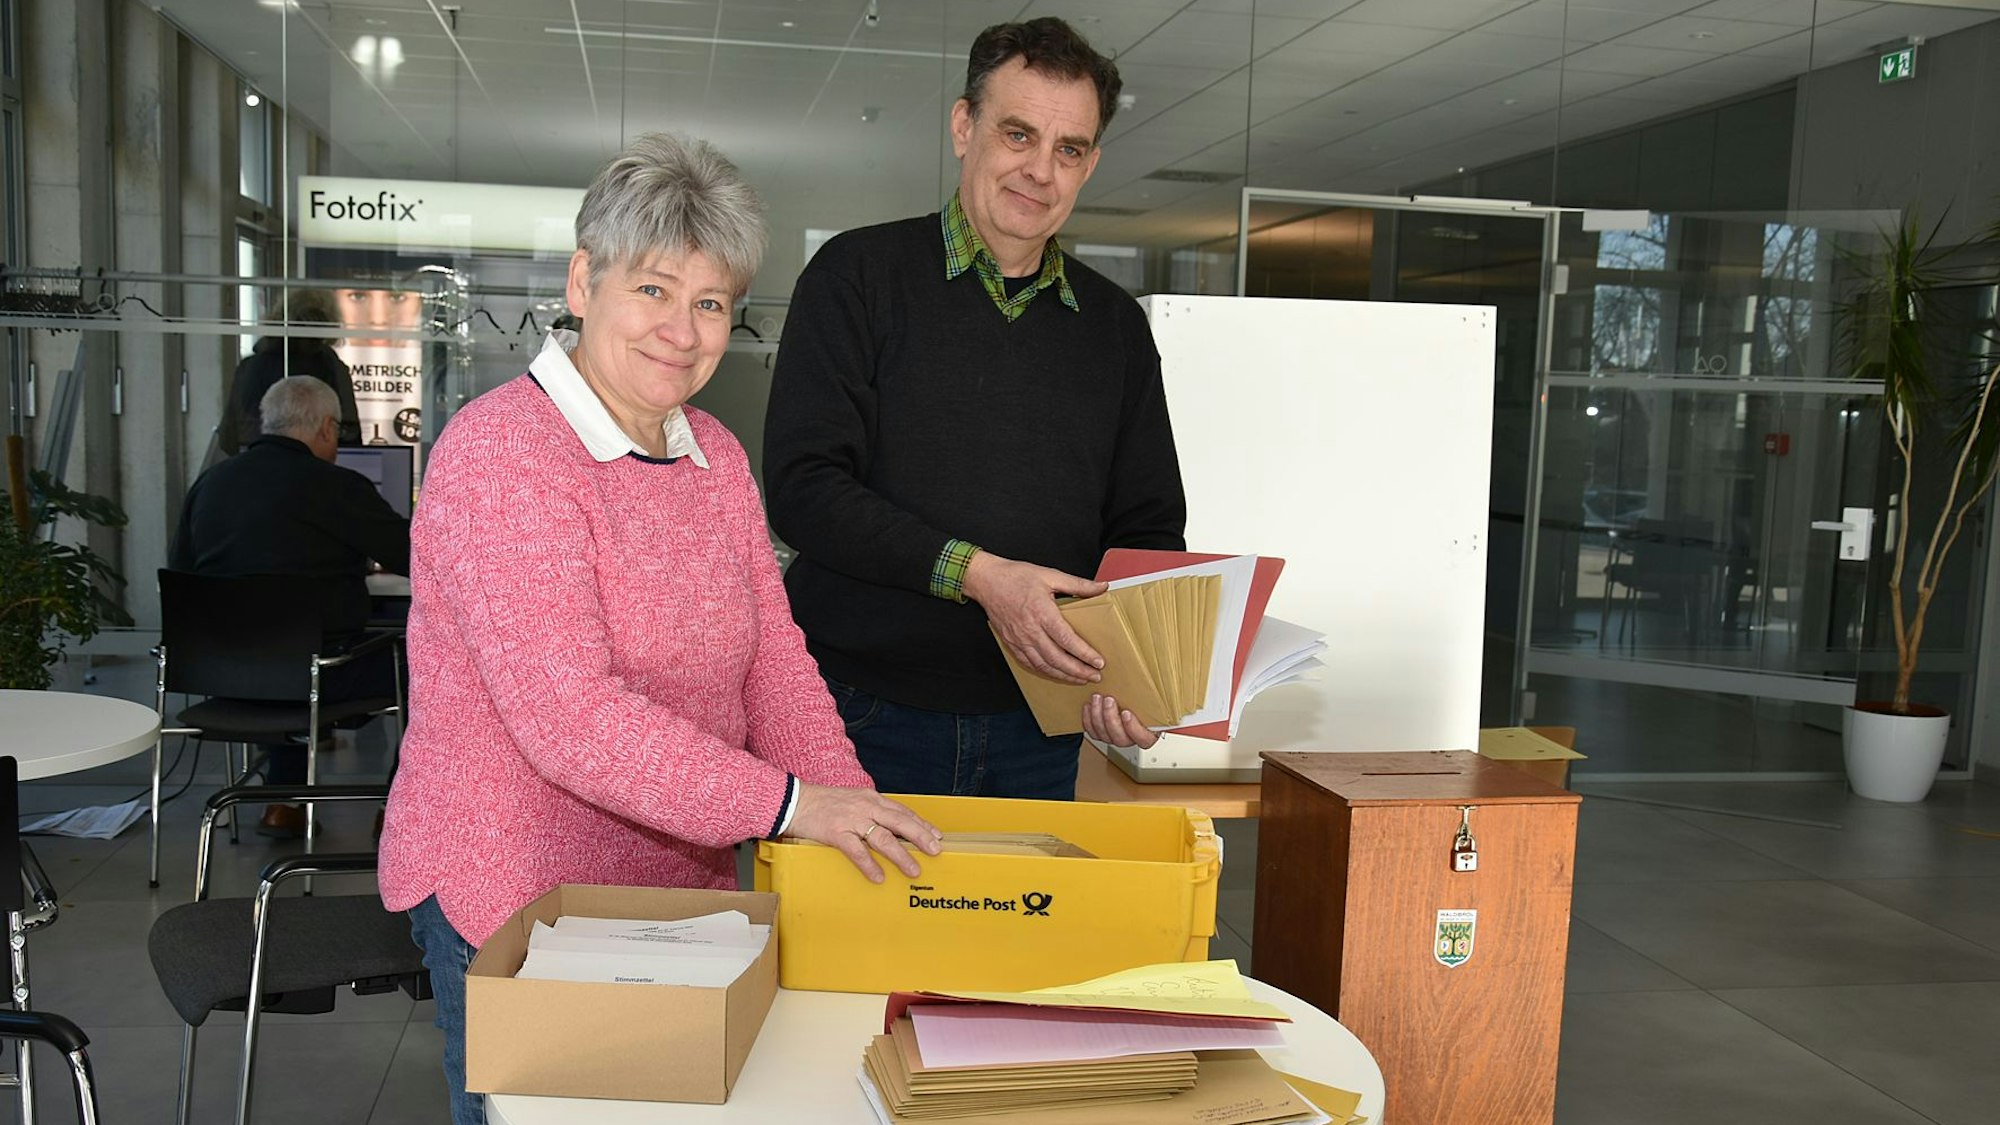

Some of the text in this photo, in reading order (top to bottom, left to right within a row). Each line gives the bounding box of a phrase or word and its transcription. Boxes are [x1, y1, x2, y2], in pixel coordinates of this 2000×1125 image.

[310, 191, 416, 221] Fotofix
[350, 364, 421, 377] METRISCH
[909, 895, 1016, 911] Deutsche Post
